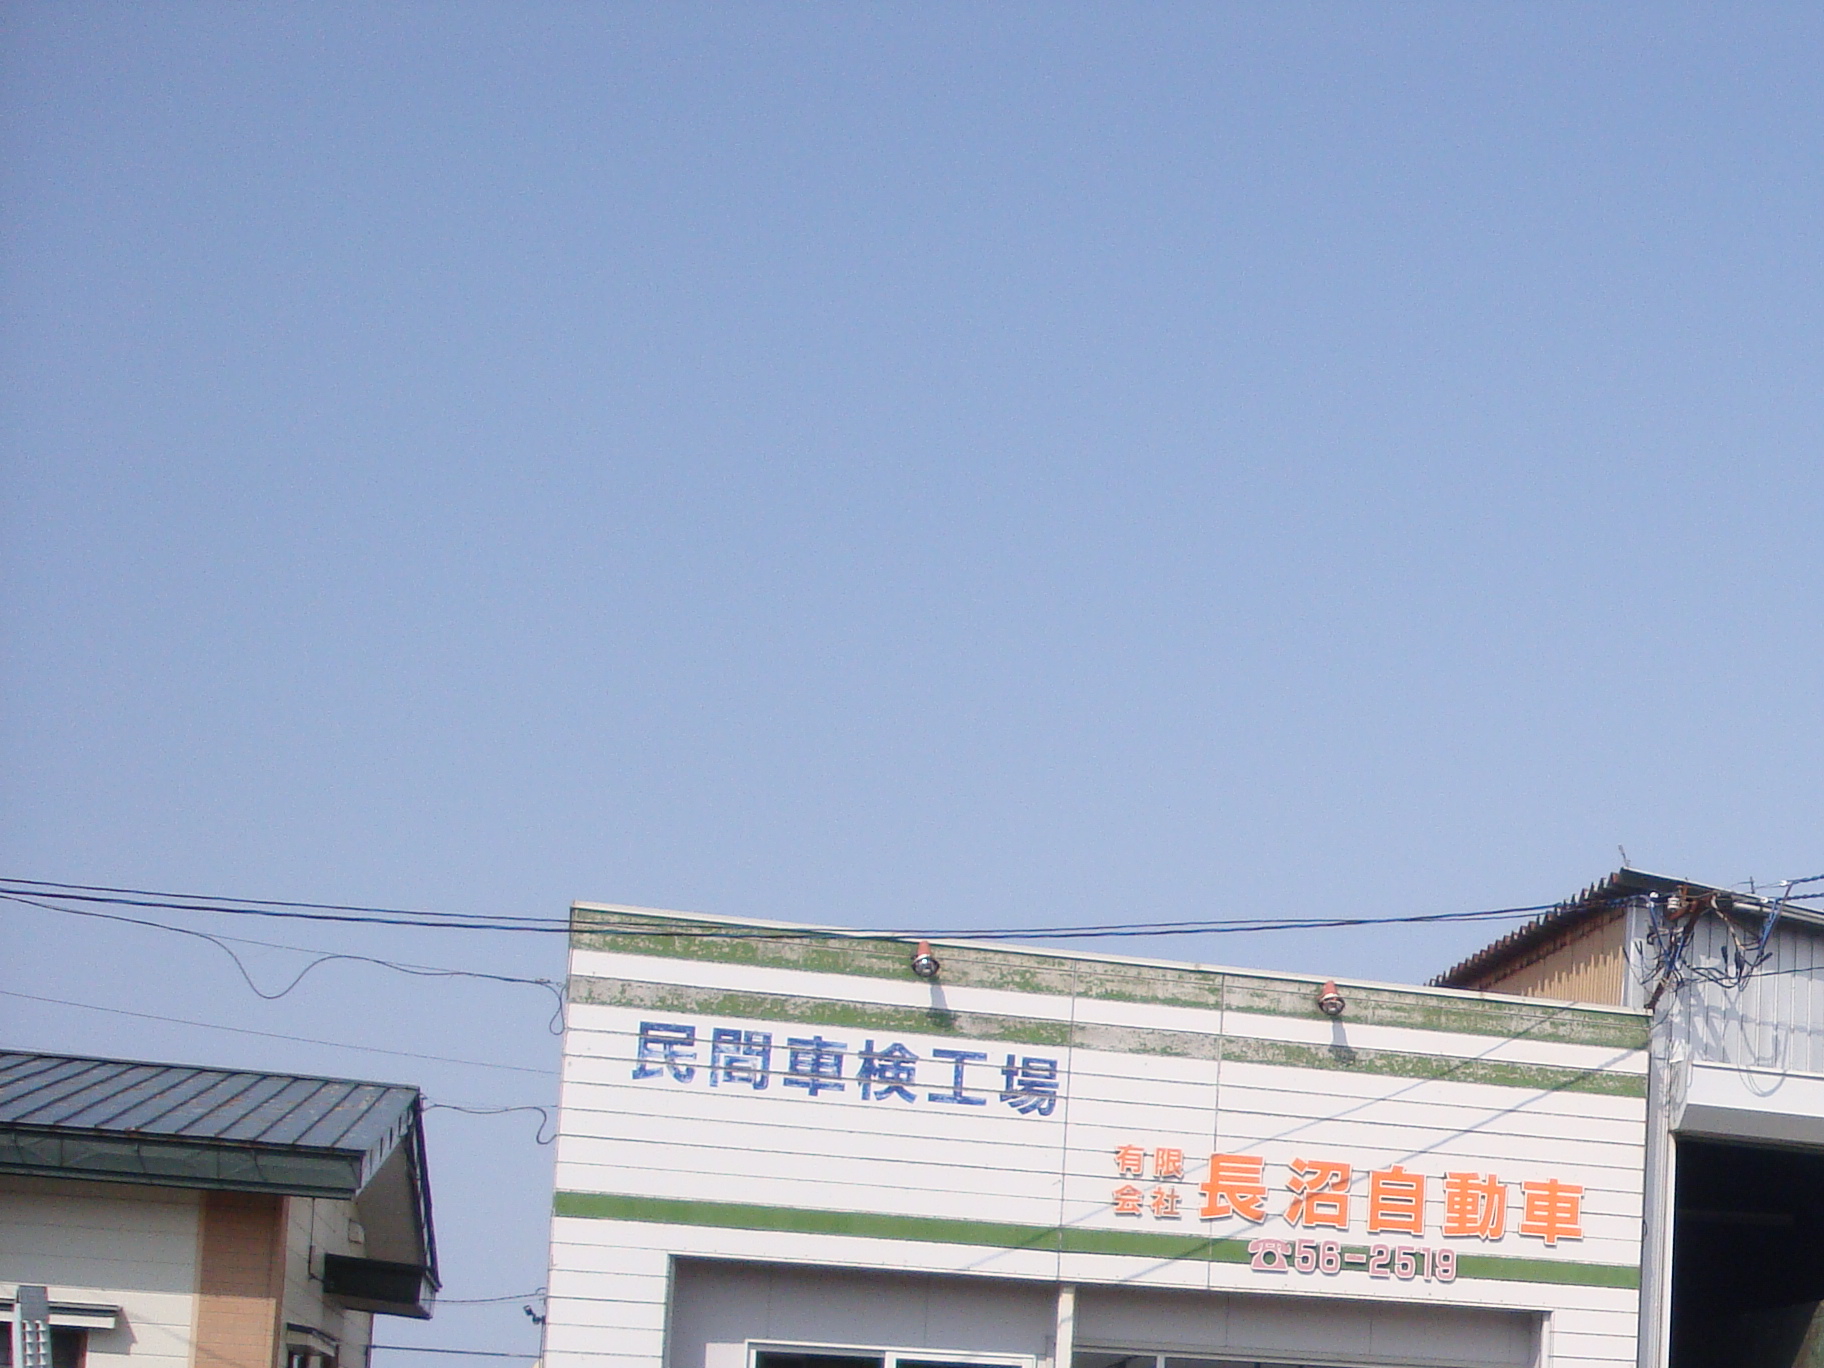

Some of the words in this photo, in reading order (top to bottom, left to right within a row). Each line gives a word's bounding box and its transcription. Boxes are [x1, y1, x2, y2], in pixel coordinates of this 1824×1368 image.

[631, 1020, 1060, 1117] 民間車検工場
[1113, 1143, 1185, 1180] 有限
[1111, 1184, 1183, 1219] 会社
[1199, 1152, 1585, 1247] 長沼自動車
[1293, 1238, 1458, 1282] 56-2519
